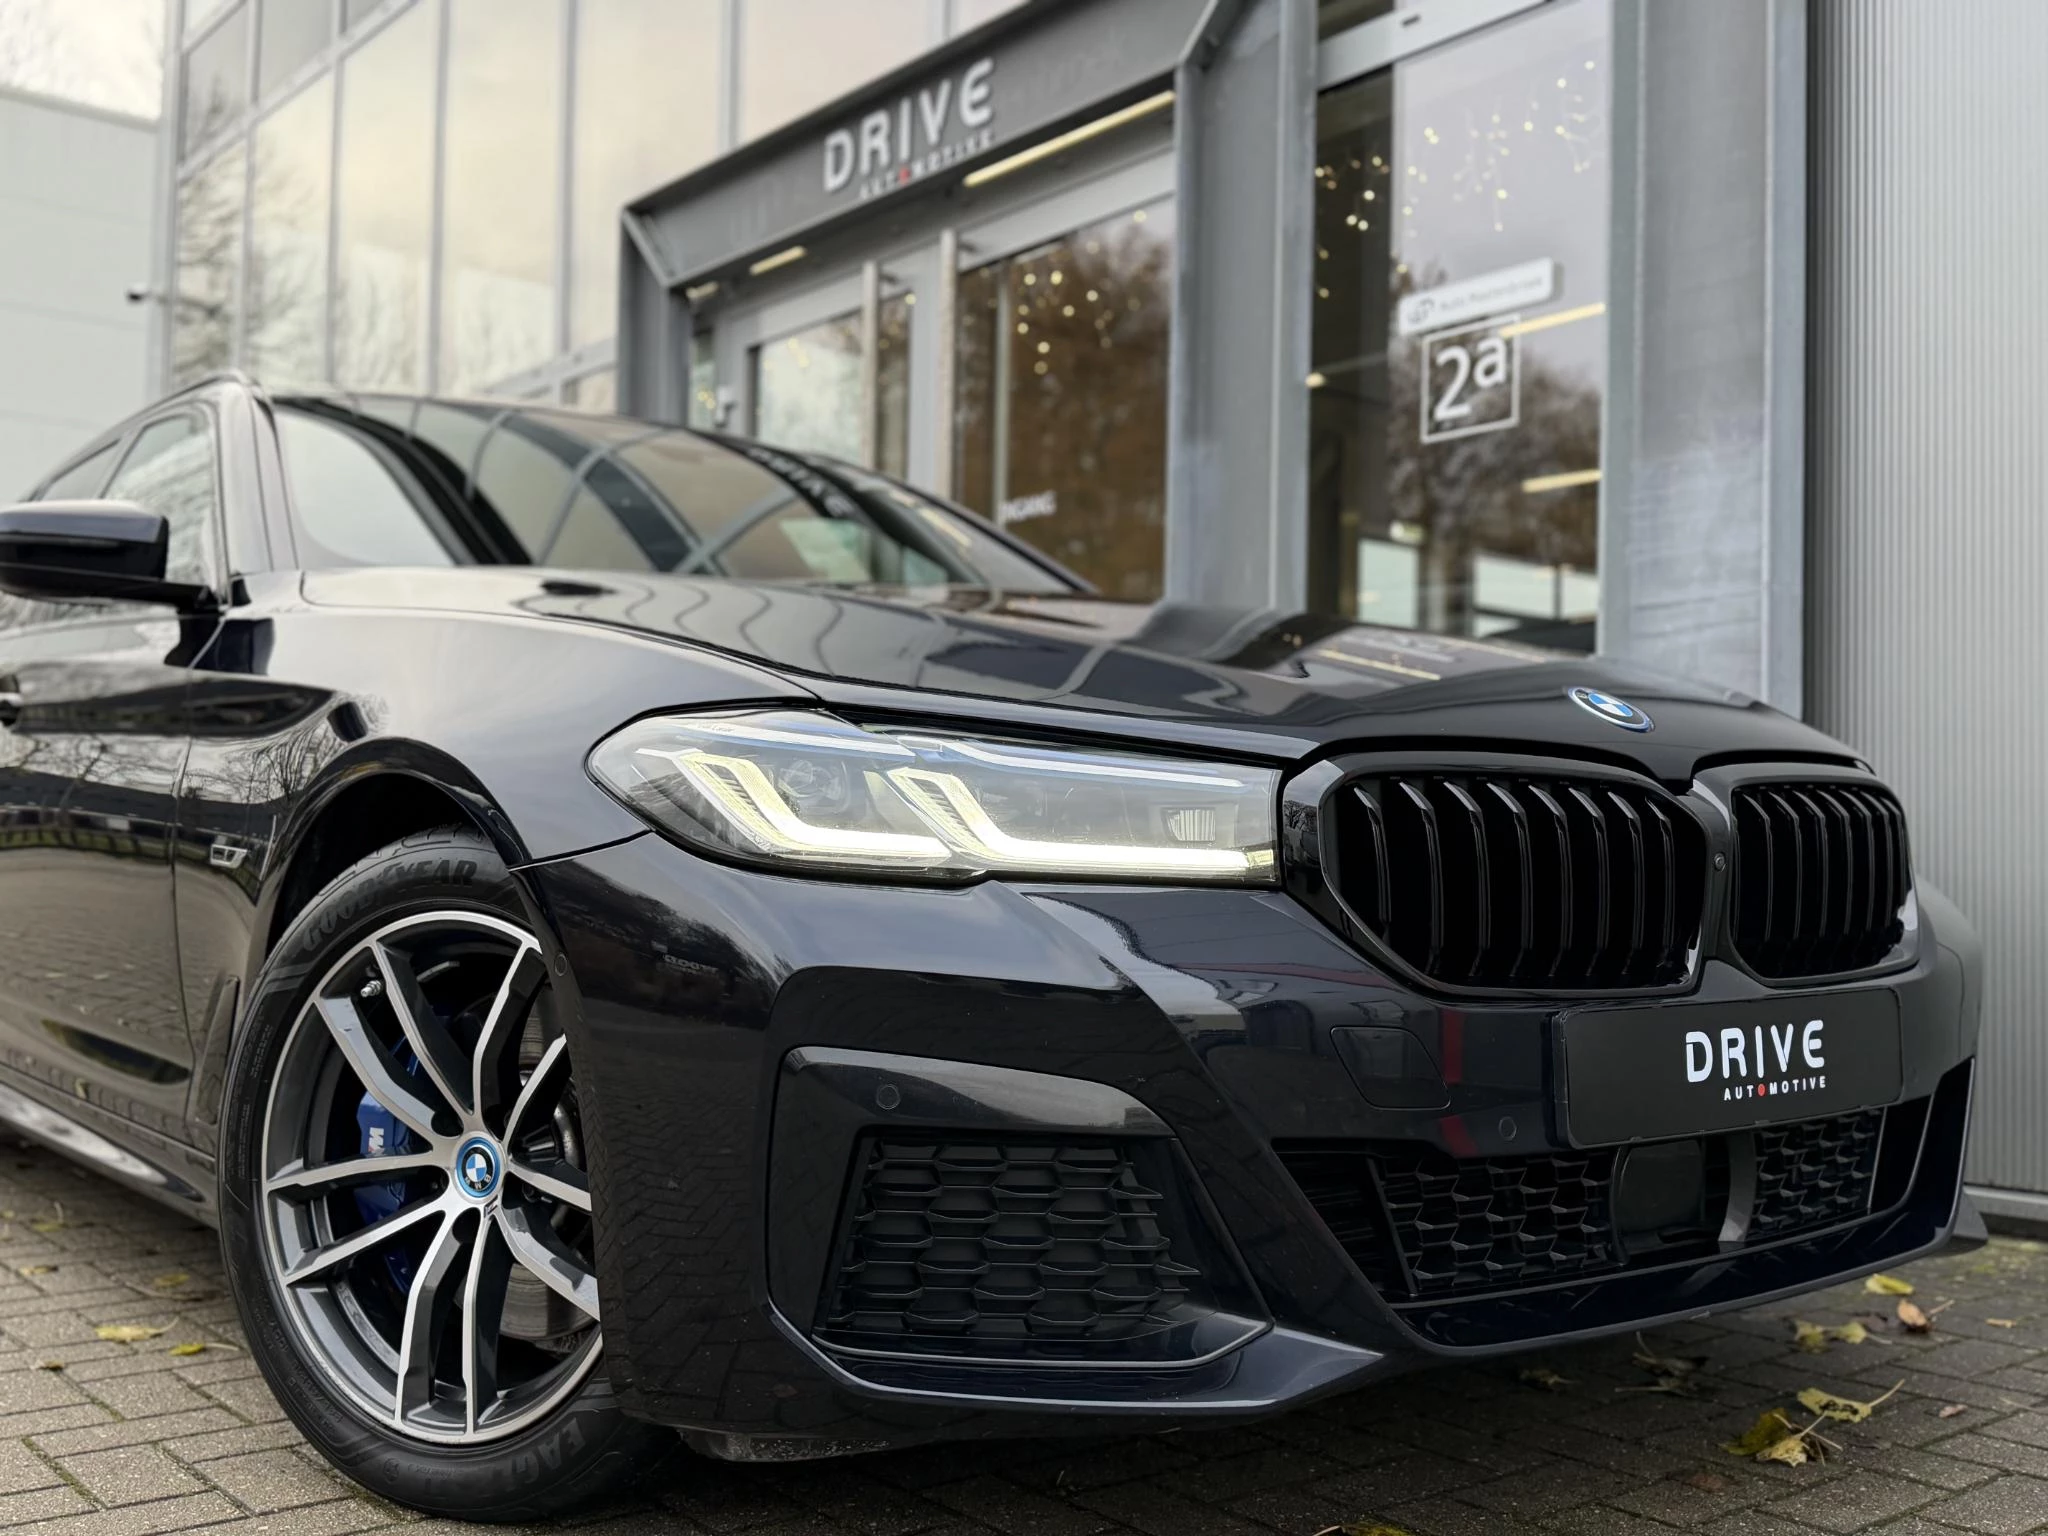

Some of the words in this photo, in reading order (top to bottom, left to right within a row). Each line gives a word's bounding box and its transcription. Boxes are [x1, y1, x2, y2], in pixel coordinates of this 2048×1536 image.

[823, 56, 993, 193] DRIVE
[1433, 336, 1507, 422] 2a
[1685, 1019, 1825, 1083] DRIVE
[1723, 1076, 1826, 1101] AUTOMOTIVE
